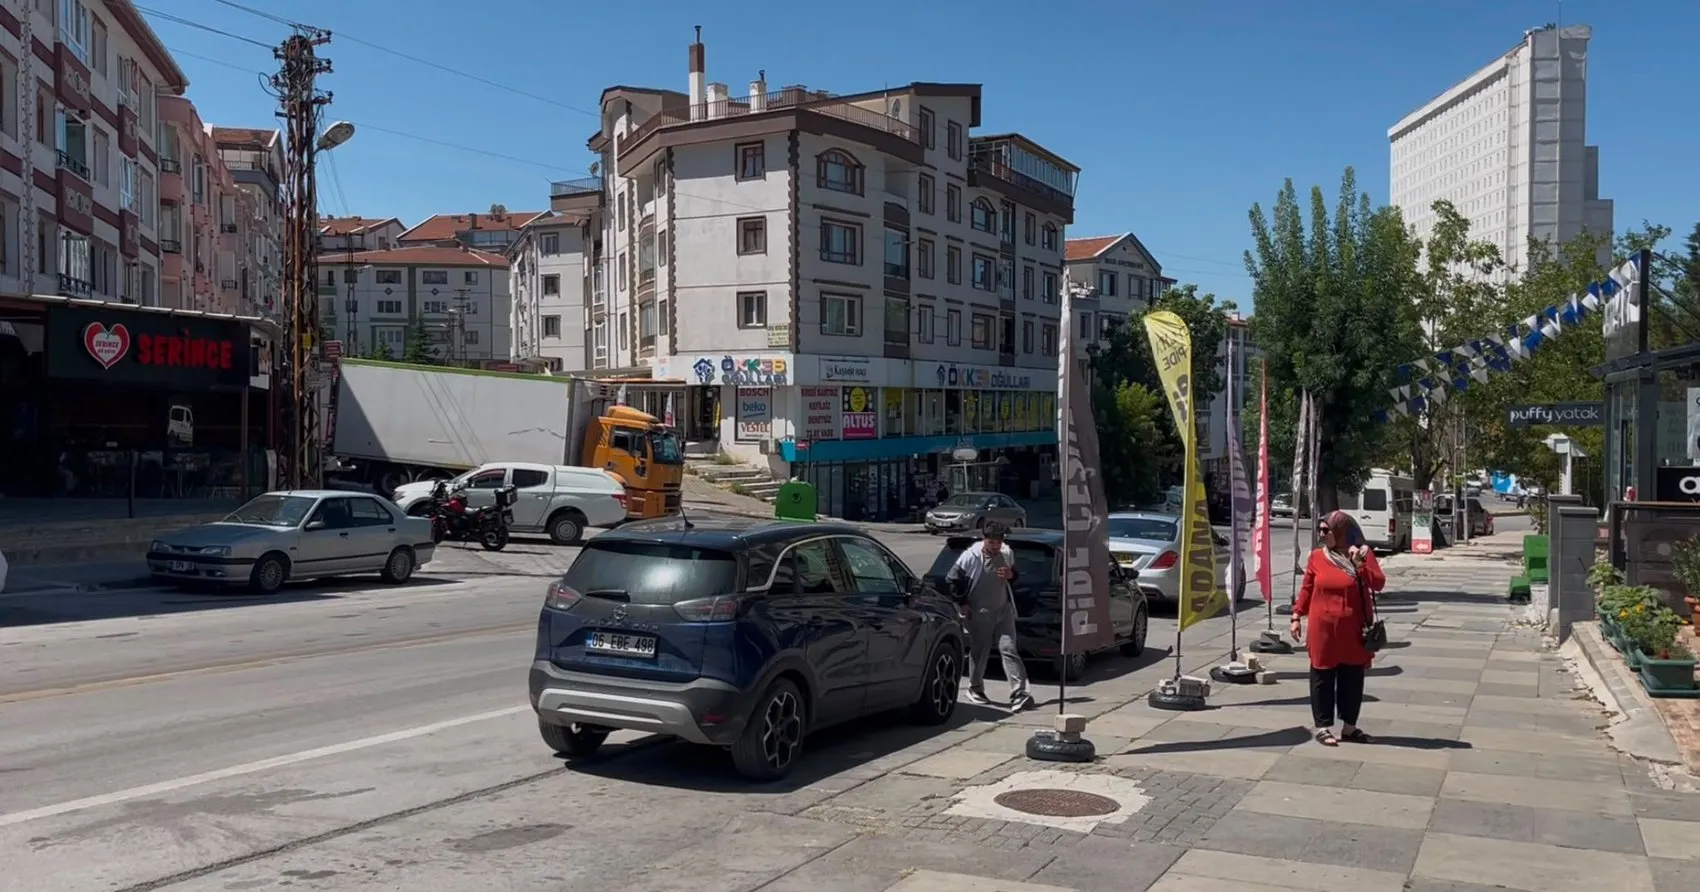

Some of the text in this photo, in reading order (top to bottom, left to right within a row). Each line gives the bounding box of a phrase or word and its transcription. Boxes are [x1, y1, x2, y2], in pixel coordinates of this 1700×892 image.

[138, 327, 233, 369] SERİNCE
[739, 388, 769, 397] BOSCH
[742, 401, 767, 412] beko
[843, 414, 876, 429] ALTUS
[1510, 406, 1599, 423] puffy yatak
[740, 422, 770, 433] VESTEL
[592, 632, 604, 648] 06
[634, 637, 654, 653] 498
